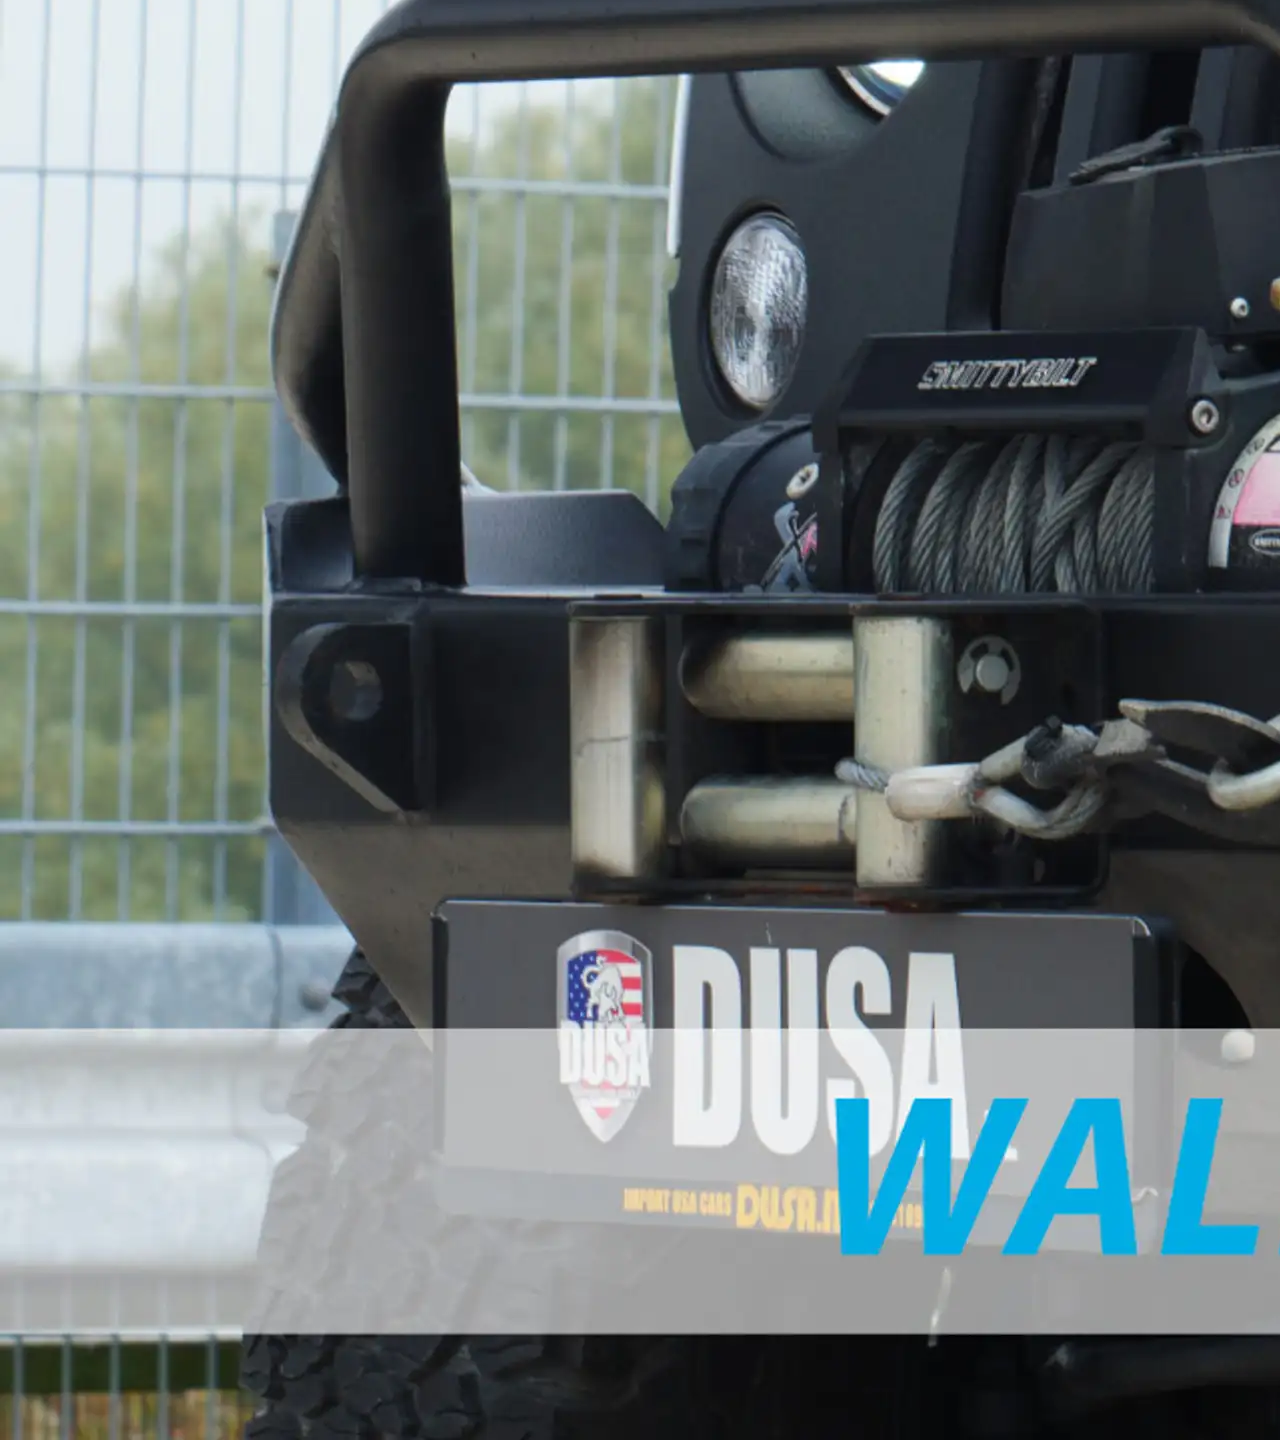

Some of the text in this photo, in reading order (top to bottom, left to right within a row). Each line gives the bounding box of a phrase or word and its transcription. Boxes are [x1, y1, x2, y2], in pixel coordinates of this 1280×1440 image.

[917, 356, 1098, 390] SMITTYBILT
[560, 1019, 651, 1087] DUSA
[672, 944, 970, 1160] DUSA
